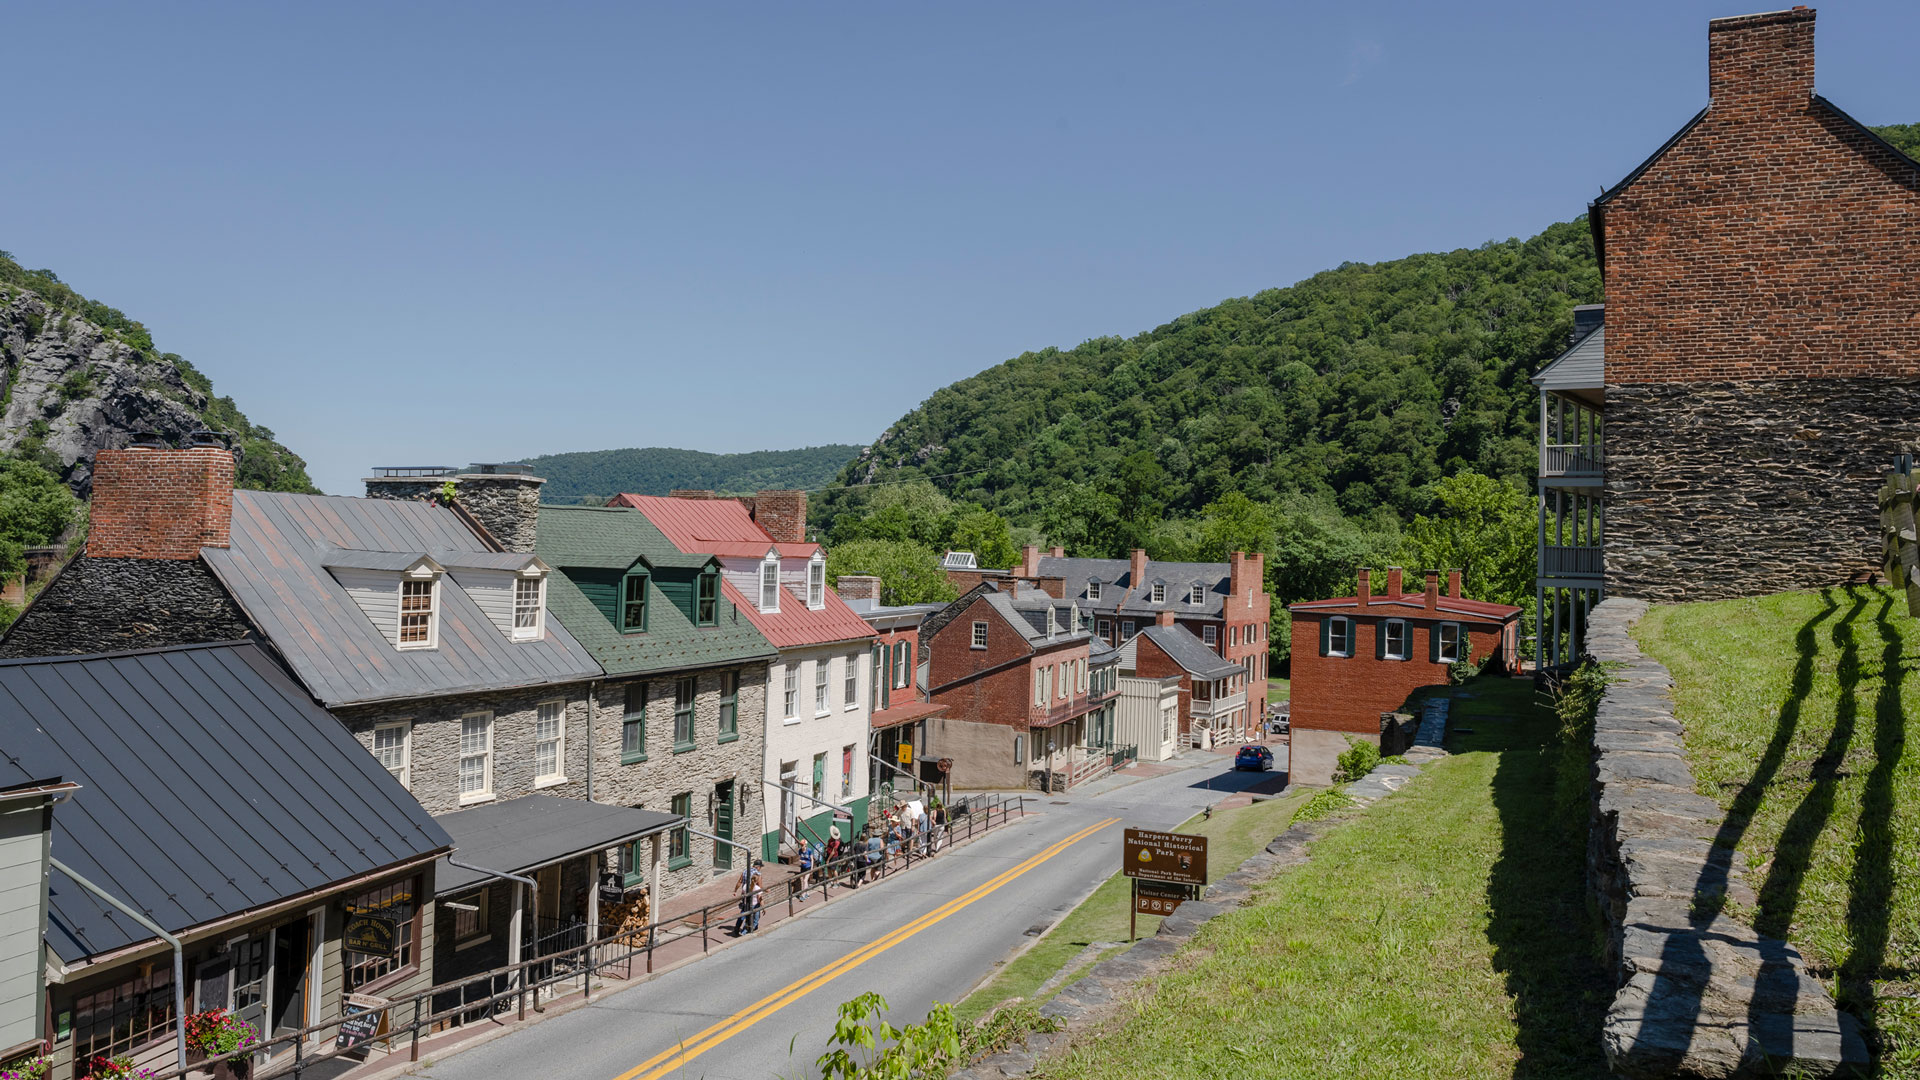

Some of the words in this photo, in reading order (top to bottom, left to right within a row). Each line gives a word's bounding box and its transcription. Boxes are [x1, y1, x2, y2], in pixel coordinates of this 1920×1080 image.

[1138, 832, 1169, 841] Harpers
[1172, 835, 1193, 844] Ferry
[1128, 838, 1160, 847] National
[1164, 842, 1203, 852] Historical
[1156, 848, 1174, 857] Park
[1140, 889, 1159, 897] Visitor
[347, 919, 368, 932] COACH
[370, 919, 391, 939] HOUSE
